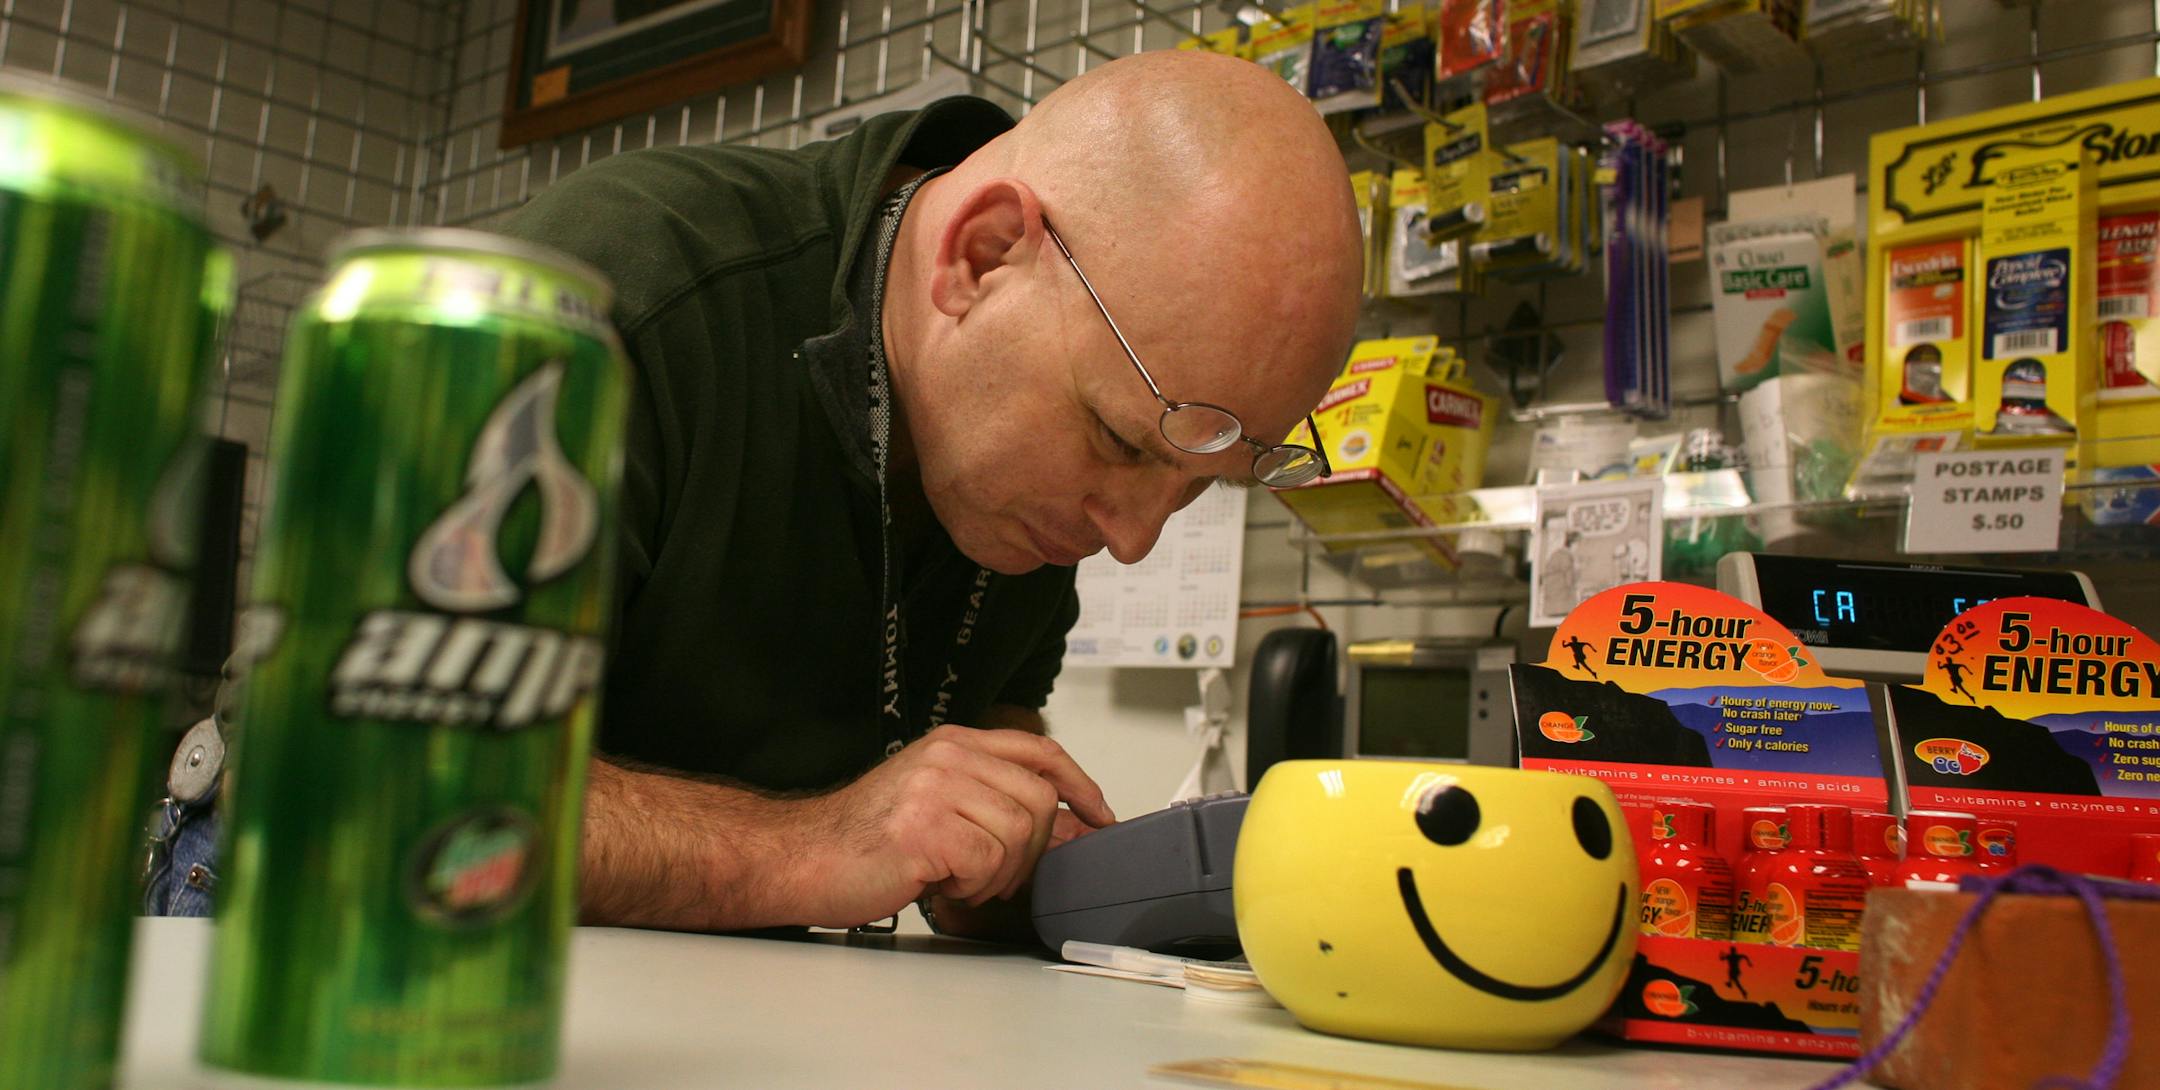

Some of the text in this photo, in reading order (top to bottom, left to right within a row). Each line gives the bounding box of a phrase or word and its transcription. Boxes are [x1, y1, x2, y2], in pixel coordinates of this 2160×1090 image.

[1935, 458, 2052, 478] POSTAGE
[1943, 485, 2045, 503] STAMPS
[1972, 513, 2024, 531] $.50
[957, 568, 992, 645] GEAR
[1619, 594, 1752, 638] 5-hour
[1998, 611, 2132, 657] 5-hour
[884, 603, 901, 719] TOMMY
[1605, 638, 1753, 671] ENERGY
[1982, 655, 2160, 699] ENERGY
[1720, 696, 1753, 707] Hours
[1755, 697, 1767, 707] of
[1769, 699, 1807, 711] energy
[1723, 708, 1738, 718] No
[1740, 708, 1771, 720] crash
[1725, 722, 1783, 736] Sugar free
[2104, 721, 2139, 733] Hours
[2141, 723, 2153, 734] of
[1728, 737, 1809, 753] Only 4 calories
[1927, 745, 1957, 755] BERRY
[2109, 737, 2160, 750] No crash
[2113, 753, 2140, 765] Zero
[1661, 772, 1735, 786] enzymes
[1758, 778, 1808, 790] amino
[1816, 782, 1861, 793] acids
[2117, 769, 2144, 781] Zero
[1934, 793, 2126, 814] b-vitamins enzymes
[1687, 1027, 1860, 1052] b-vitamins enzyme
